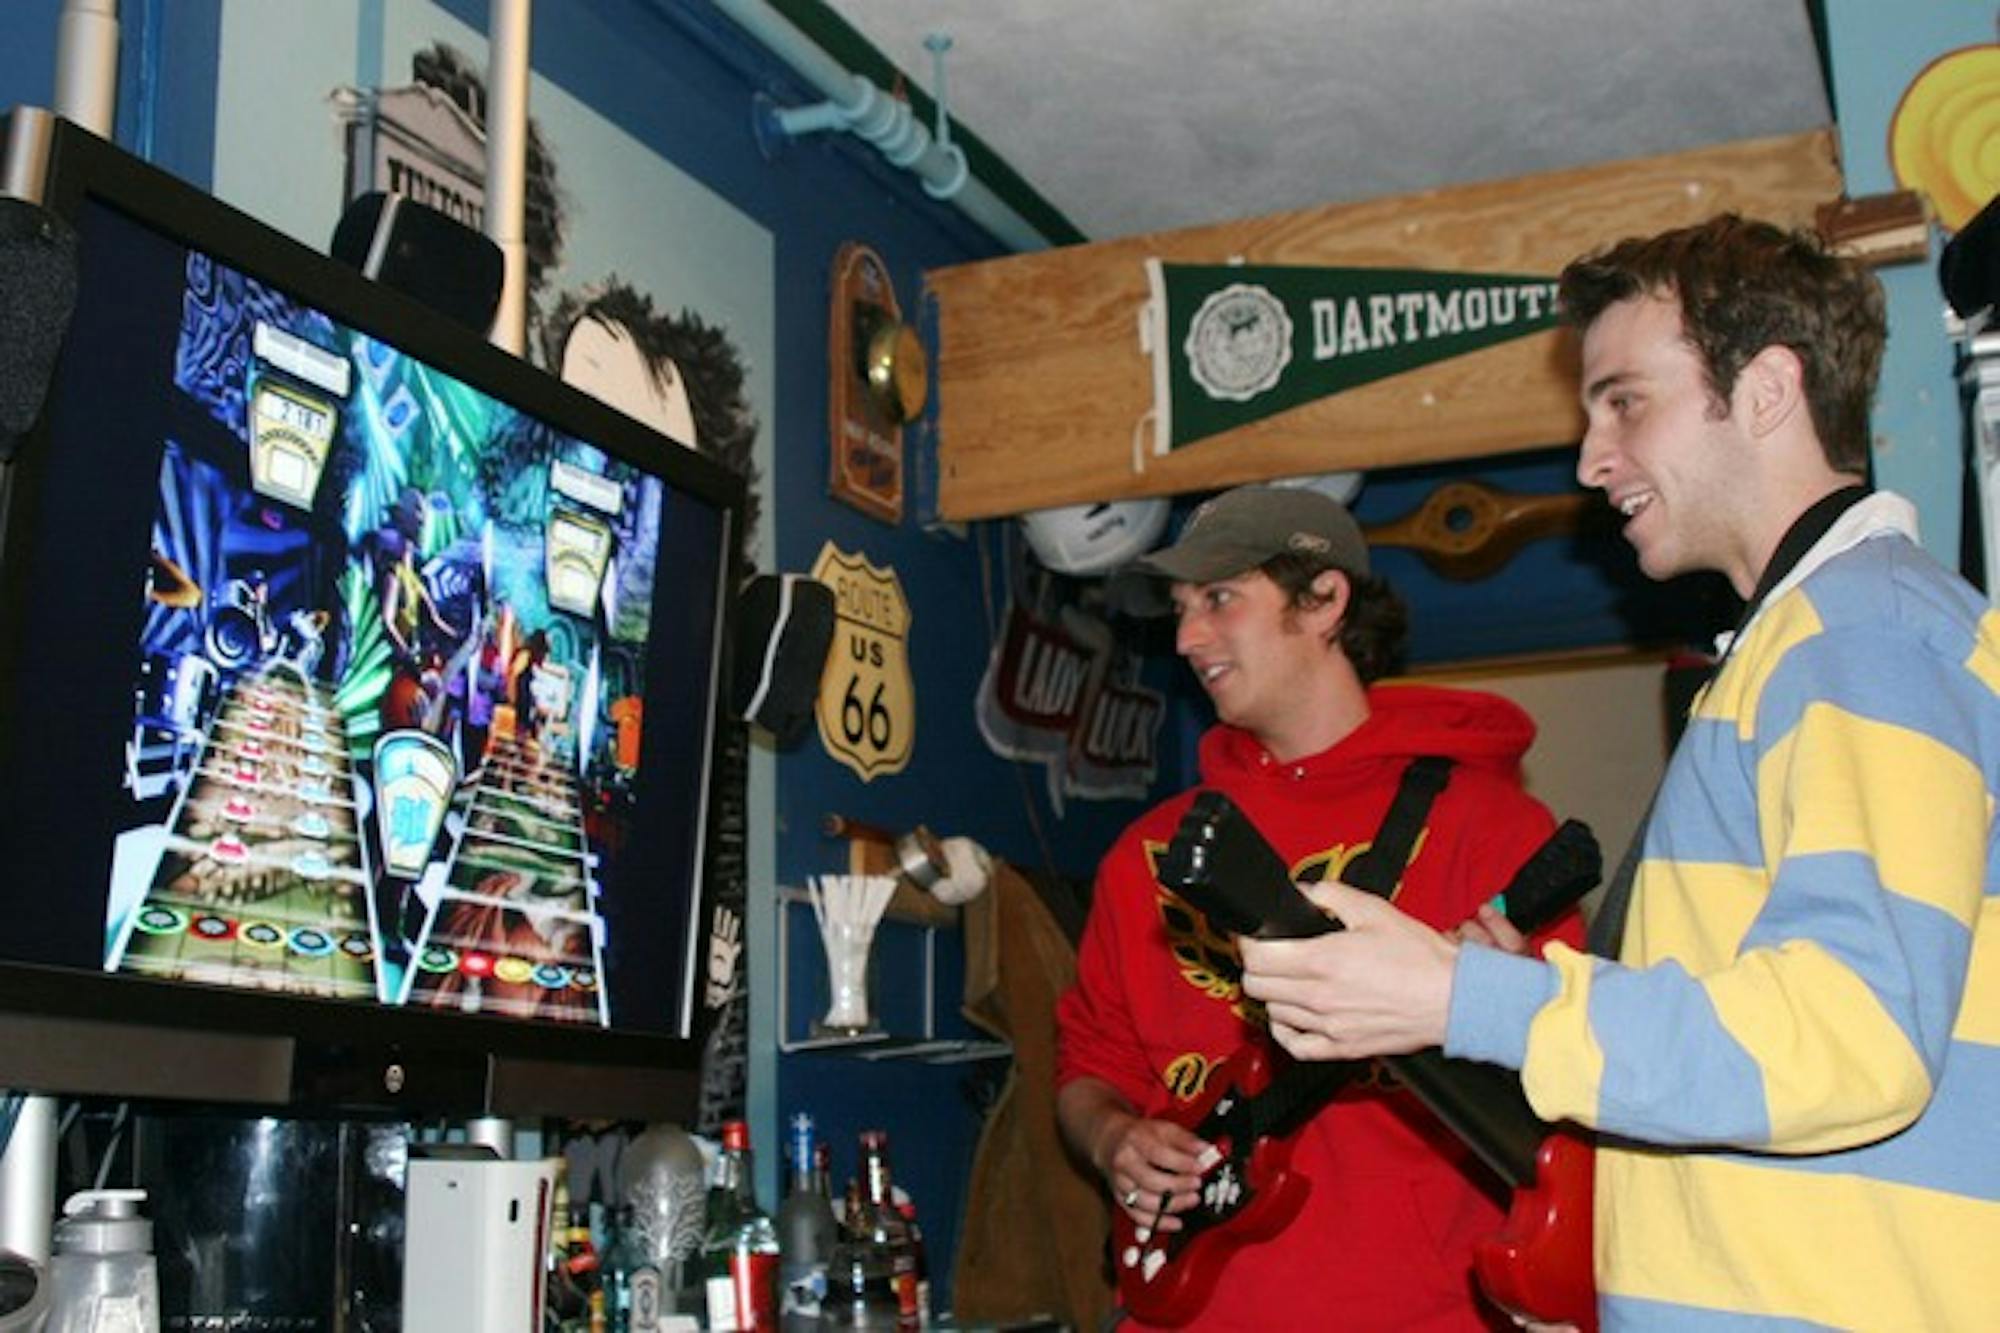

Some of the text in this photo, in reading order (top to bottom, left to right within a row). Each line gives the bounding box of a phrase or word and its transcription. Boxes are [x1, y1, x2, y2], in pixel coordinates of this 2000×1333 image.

[836, 575, 893, 628] ROUTE
[850, 635, 884, 669] US
[842, 673, 891, 752] 66
[1014, 632, 1157, 763] LADY LUCK
